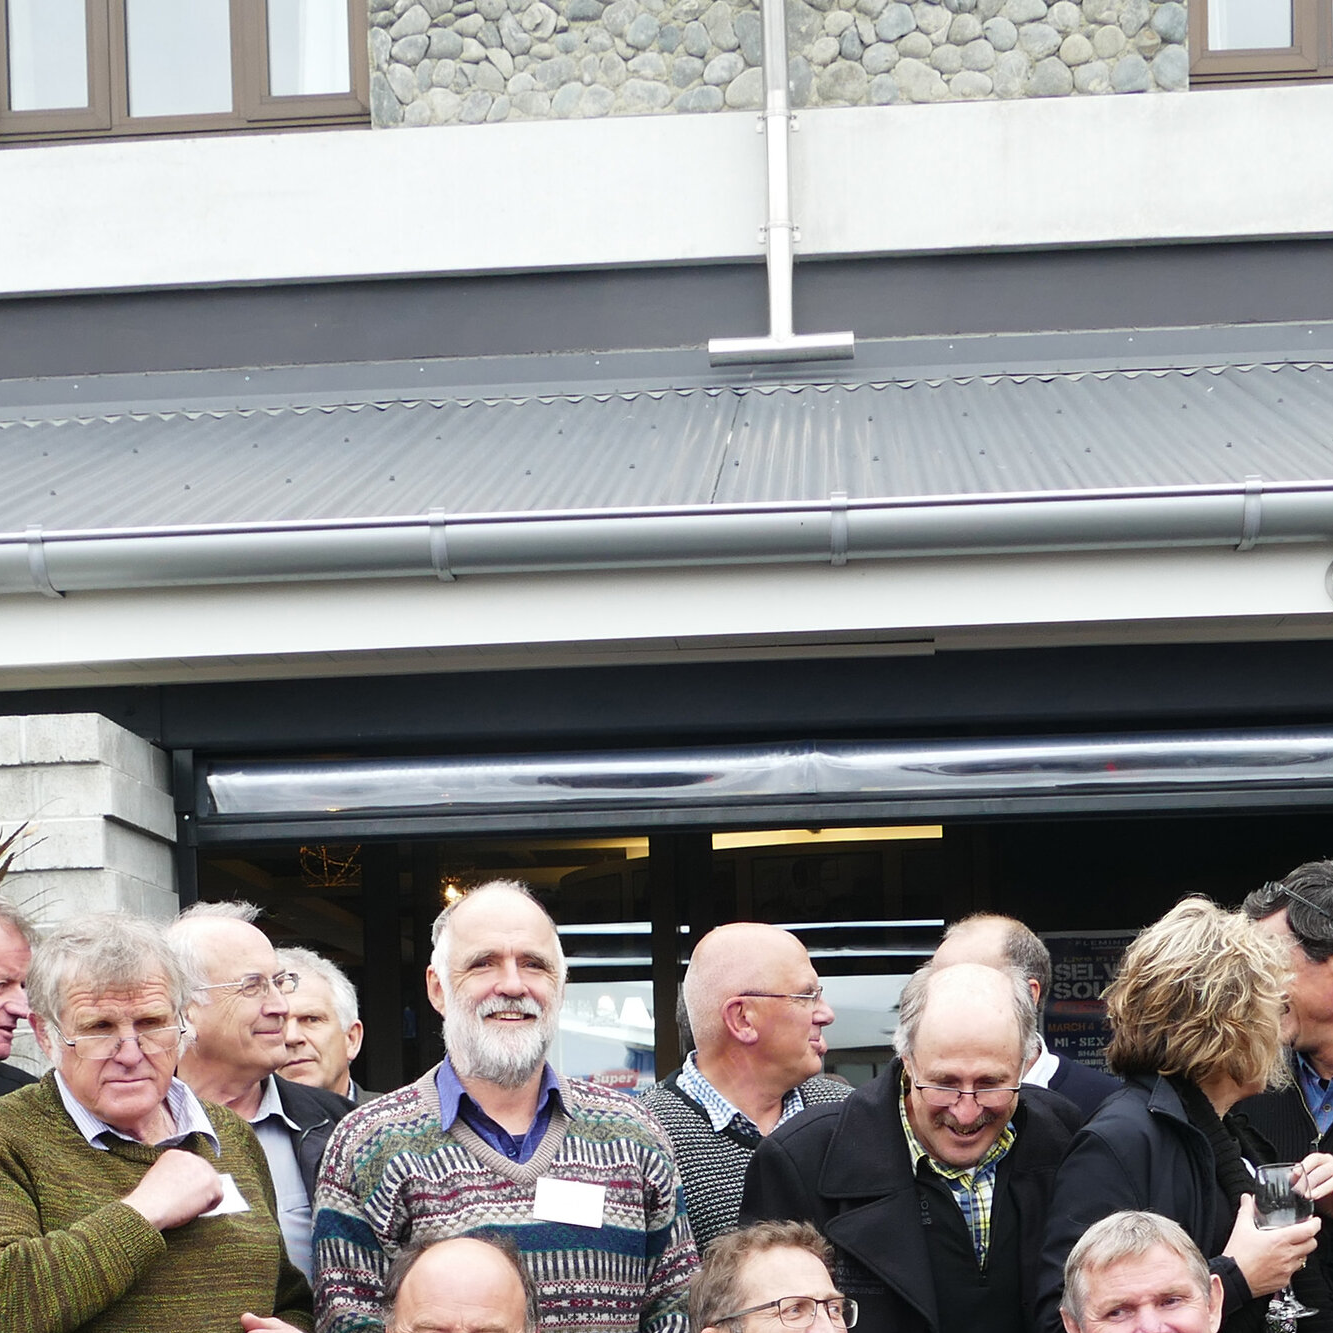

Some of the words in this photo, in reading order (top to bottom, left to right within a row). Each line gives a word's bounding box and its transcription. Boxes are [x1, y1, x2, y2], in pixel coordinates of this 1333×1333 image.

[1047, 1023, 1085, 1032] MARCH
[1054, 1037, 1069, 1047] MI
[1079, 1037, 1105, 1047] SEX
[593, 1073, 635, 1086] Super
